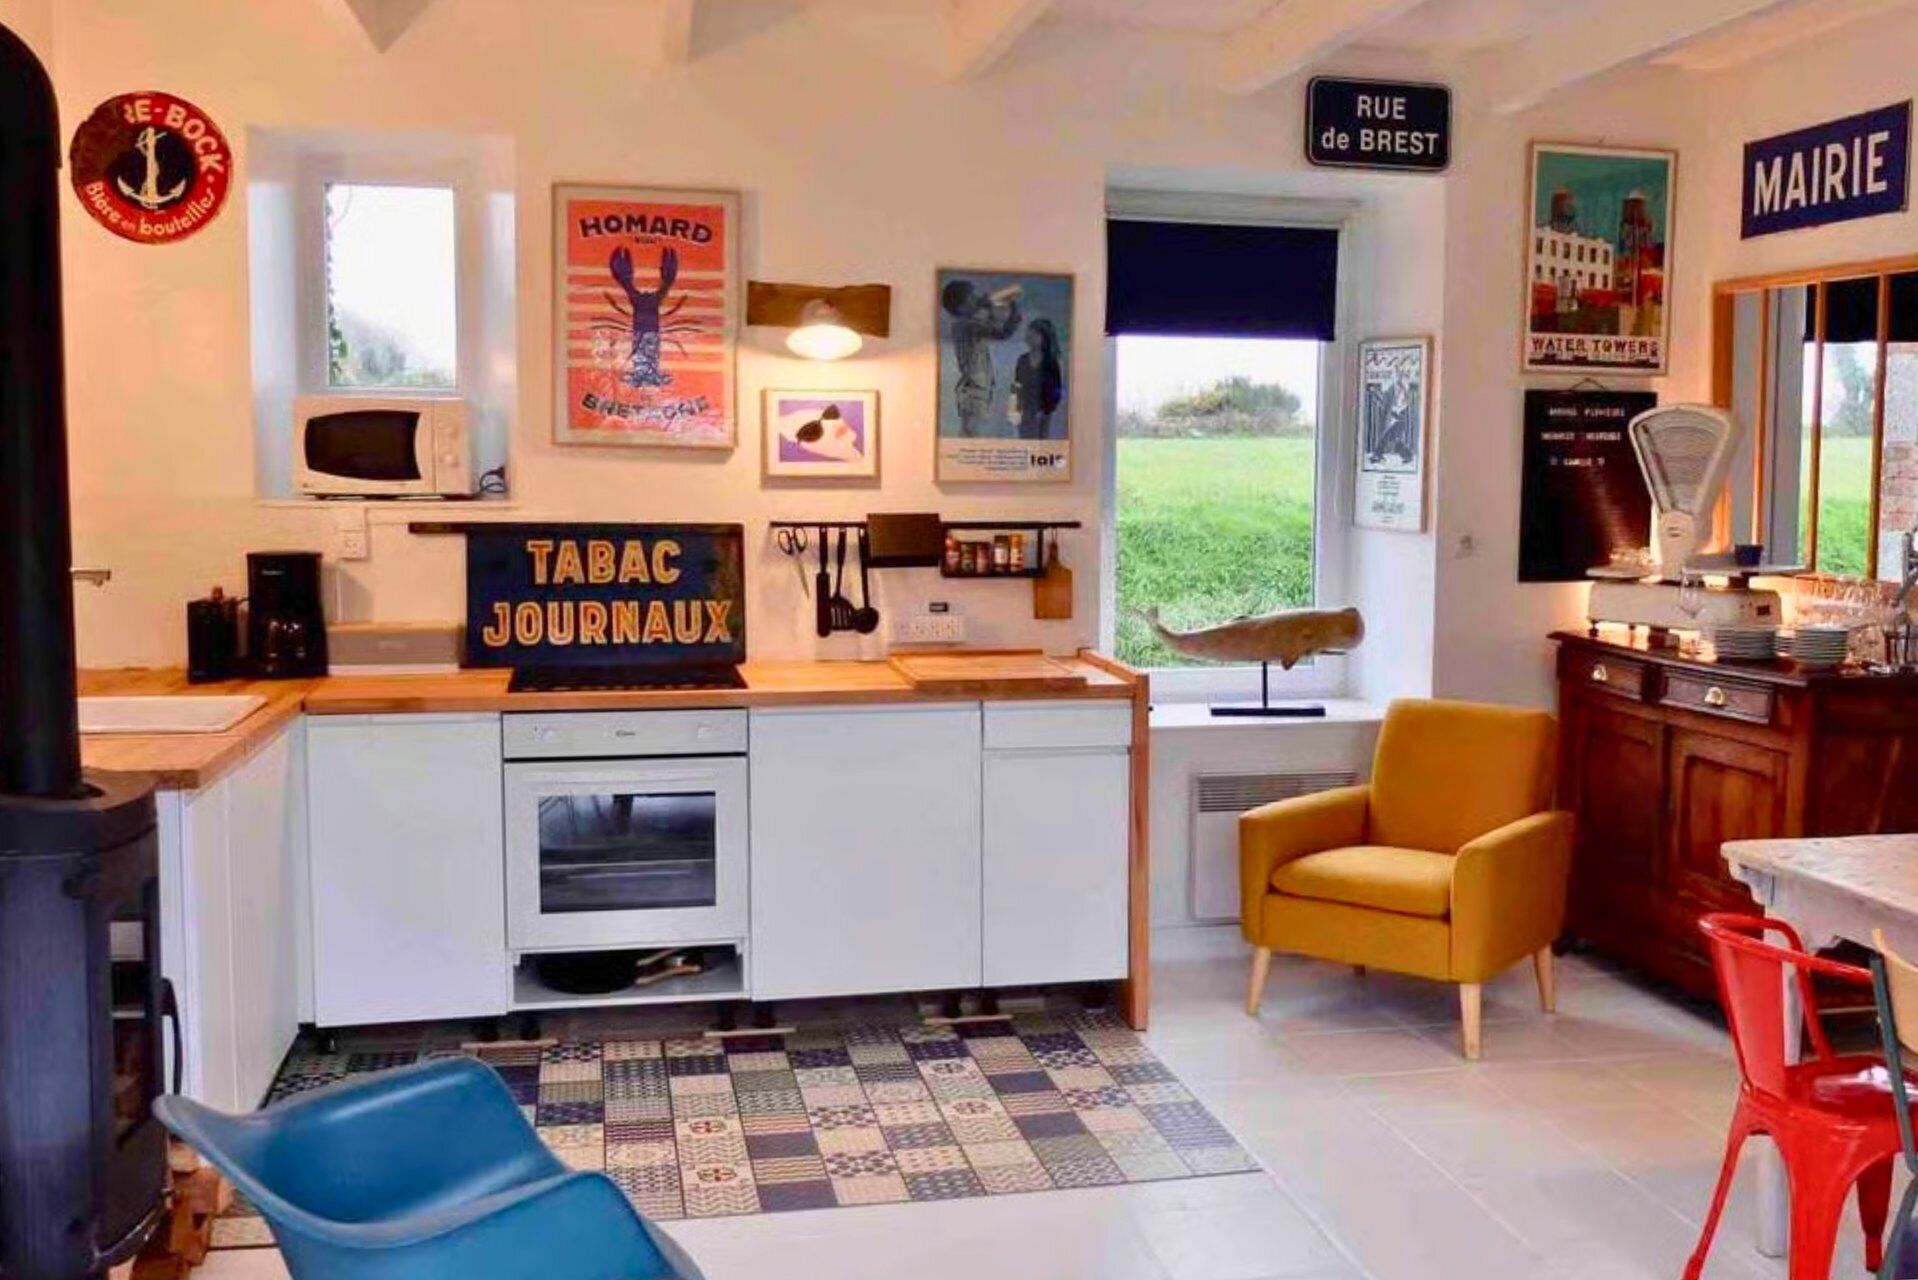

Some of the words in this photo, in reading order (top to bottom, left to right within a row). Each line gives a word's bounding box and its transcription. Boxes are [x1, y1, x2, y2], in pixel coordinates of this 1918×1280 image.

[1357, 95, 1406, 120] RUE
[1321, 127, 1350, 150] de
[1360, 129, 1439, 155] BREST
[1753, 130, 1890, 216] MAIRIE
[579, 214, 713, 243] HOMARD
[1532, 337, 1587, 353] WATER
[1591, 339, 1659, 357] TOWERS
[527, 540, 682, 585] TABAC
[482, 600, 733, 647] JOURNAUX
